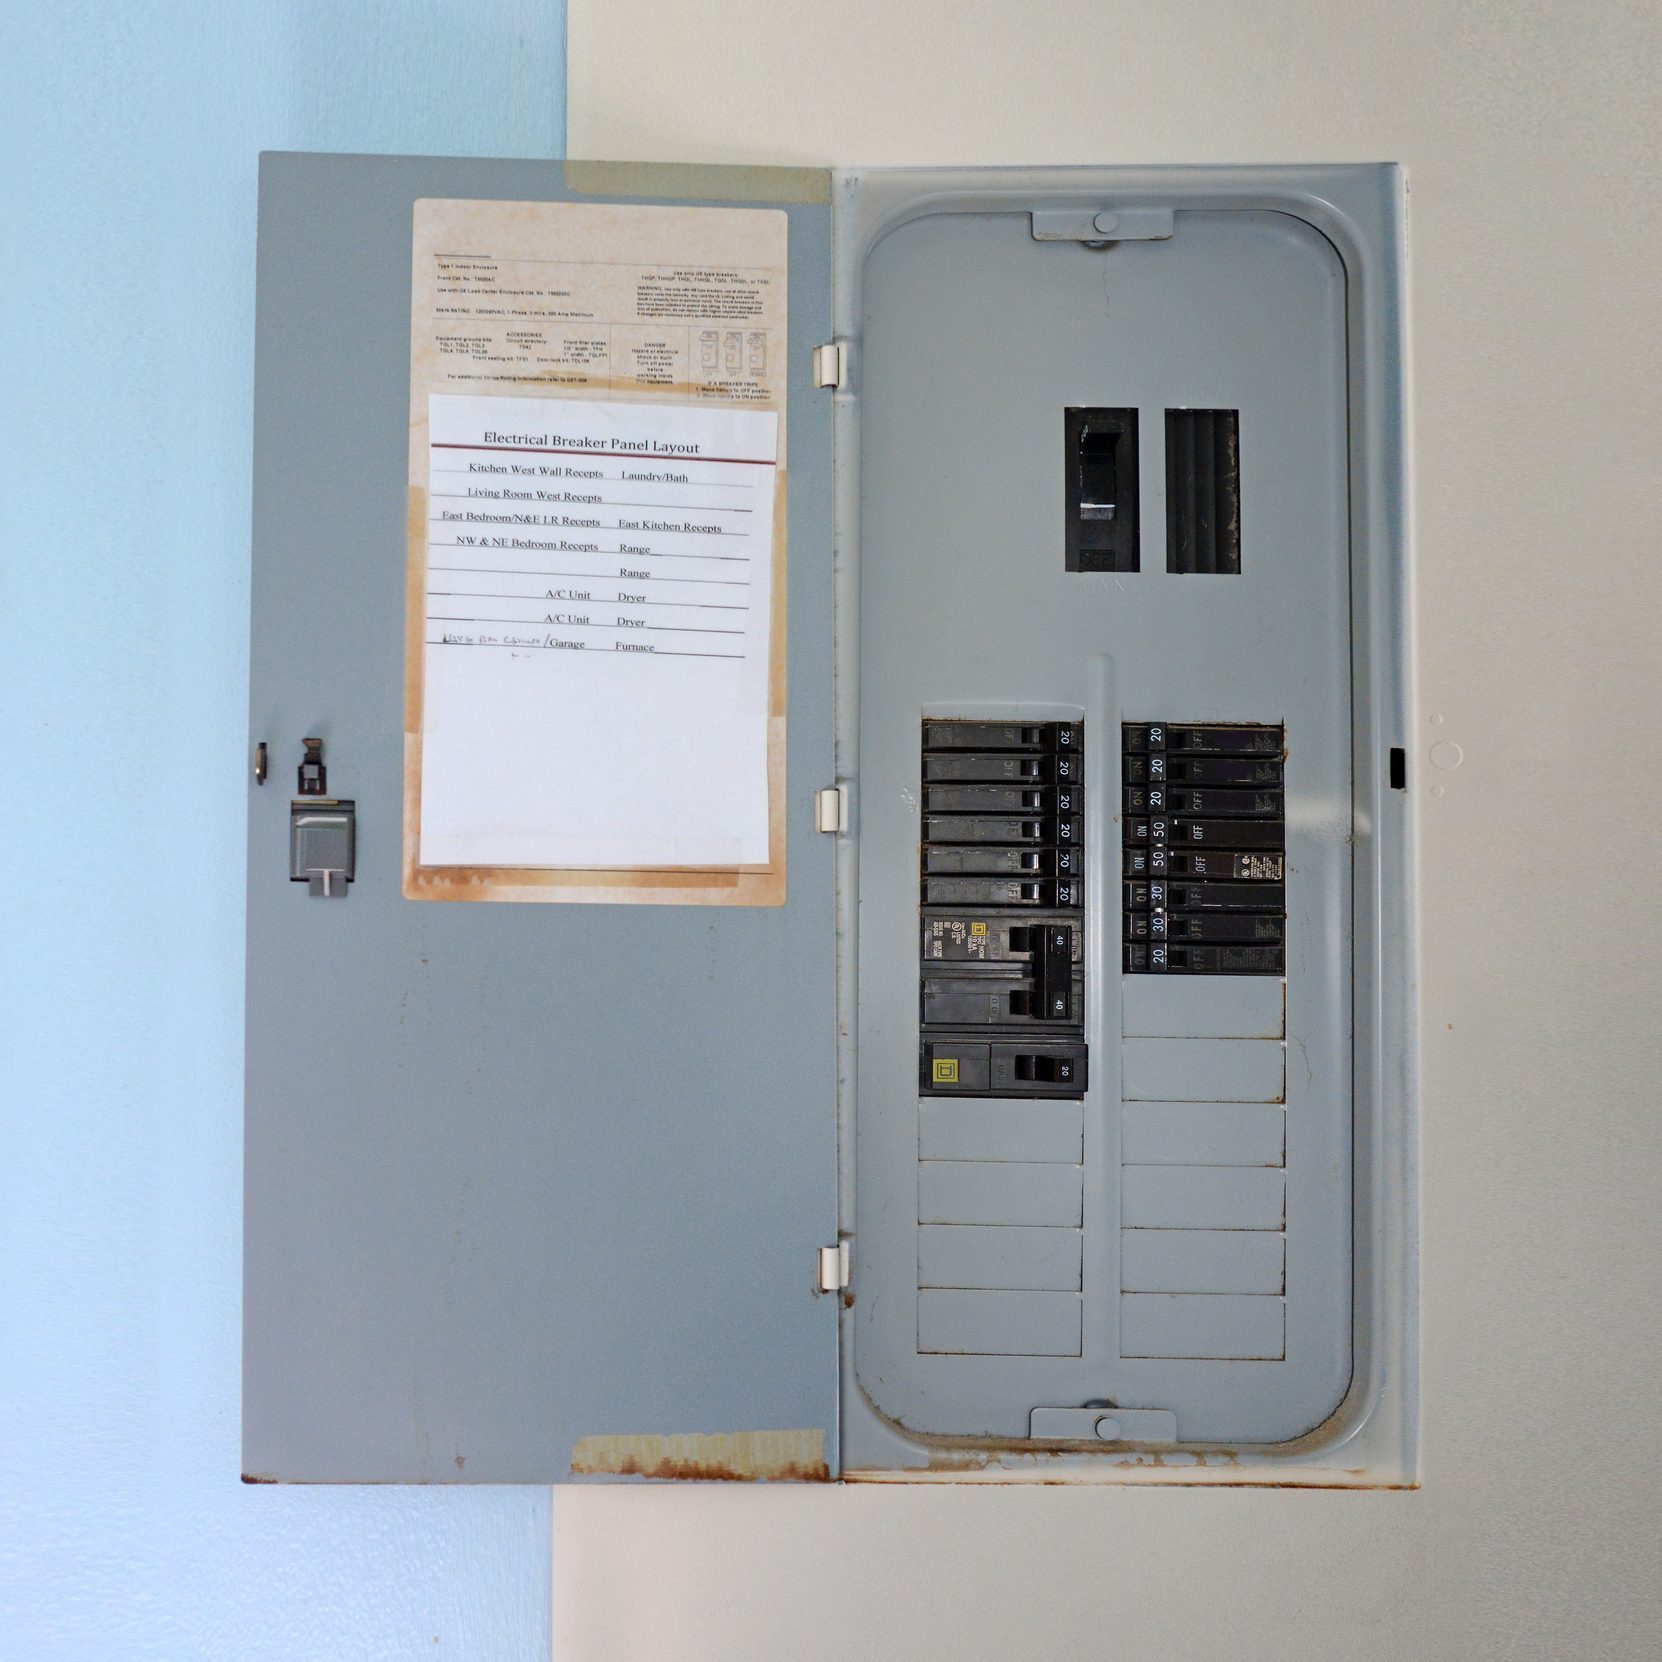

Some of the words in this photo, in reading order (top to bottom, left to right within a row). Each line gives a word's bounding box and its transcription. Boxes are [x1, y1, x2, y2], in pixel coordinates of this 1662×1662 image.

[484, 431, 548, 446] Electrical
[552, 435, 608, 449] Breaker
[611, 438, 649, 451] Panel
[653, 441, 701, 455] Layout
[469, 462, 507, 474] Kitchen
[511, 465, 536, 476] West
[539, 465, 562, 476] Wall
[565, 467, 604, 480] Recepts
[621, 470, 689, 483] Laundry/Bath
[467, 488, 500, 499] Living
[503, 489, 533, 500] Room
[536, 490, 561, 501] West
[564, 492, 602, 504] Recepts
[442, 511, 463, 521] East
[466, 512, 540, 524] Bedroom/N&E
[543, 515, 559, 525] LR
[562, 517, 601, 528] Recepts
[619, 519, 639, 530] East
[642, 520, 681, 532] Kitchen
[684, 522, 722, 534] Recepts
[456, 535, 477, 545] NW
[479, 536, 489, 546] &
[492, 537, 508, 547] NE
[511, 538, 557, 550] Bedroom
[560, 540, 598, 553] Recepts
[619, 543, 651, 556] Range
[619, 568, 651, 580] Range
[545, 589, 566, 600] A/C
[569, 590, 590, 601] Unit
[618, 592, 646, 604] Dryer
[544, 614, 565, 625] A/C
[568, 614, 589, 626] Unit
[617, 617, 645, 629] Dryer
[615, 641, 654, 653] Furnace
[1060, 730, 1070, 744] 20
[1151, 728, 1162, 741] 20
[1059, 762, 1069, 776] 20
[1152, 759, 1163, 773] 20
[1060, 795, 1070, 808] 20
[1150, 791, 1161, 805] 20
[1193, 792, 1203, 810] OFF
[1060, 824, 1070, 838] 20
[1137, 825, 1147, 837] ON
[1153, 822, 1165, 837] 50
[1193, 825, 1203, 840] OFF
[1060, 854, 1070, 868] 20
[1135, 857, 1144, 869] ON
[1153, 852, 1164, 867] 50
[1196, 856, 1206, 872] OFF
[1059, 887, 1069, 901] 20
[1137, 888, 1147, 902] ON
[1152, 886, 1163, 900] 30
[1137, 920, 1147, 935] ON
[1153, 918, 1164, 932] 30
[1057, 935, 1064, 945] 40
[1153, 949, 1164, 963] 20
[1056, 1000, 1063, 1010] 40
[1061, 1066, 1069, 1076] 20
